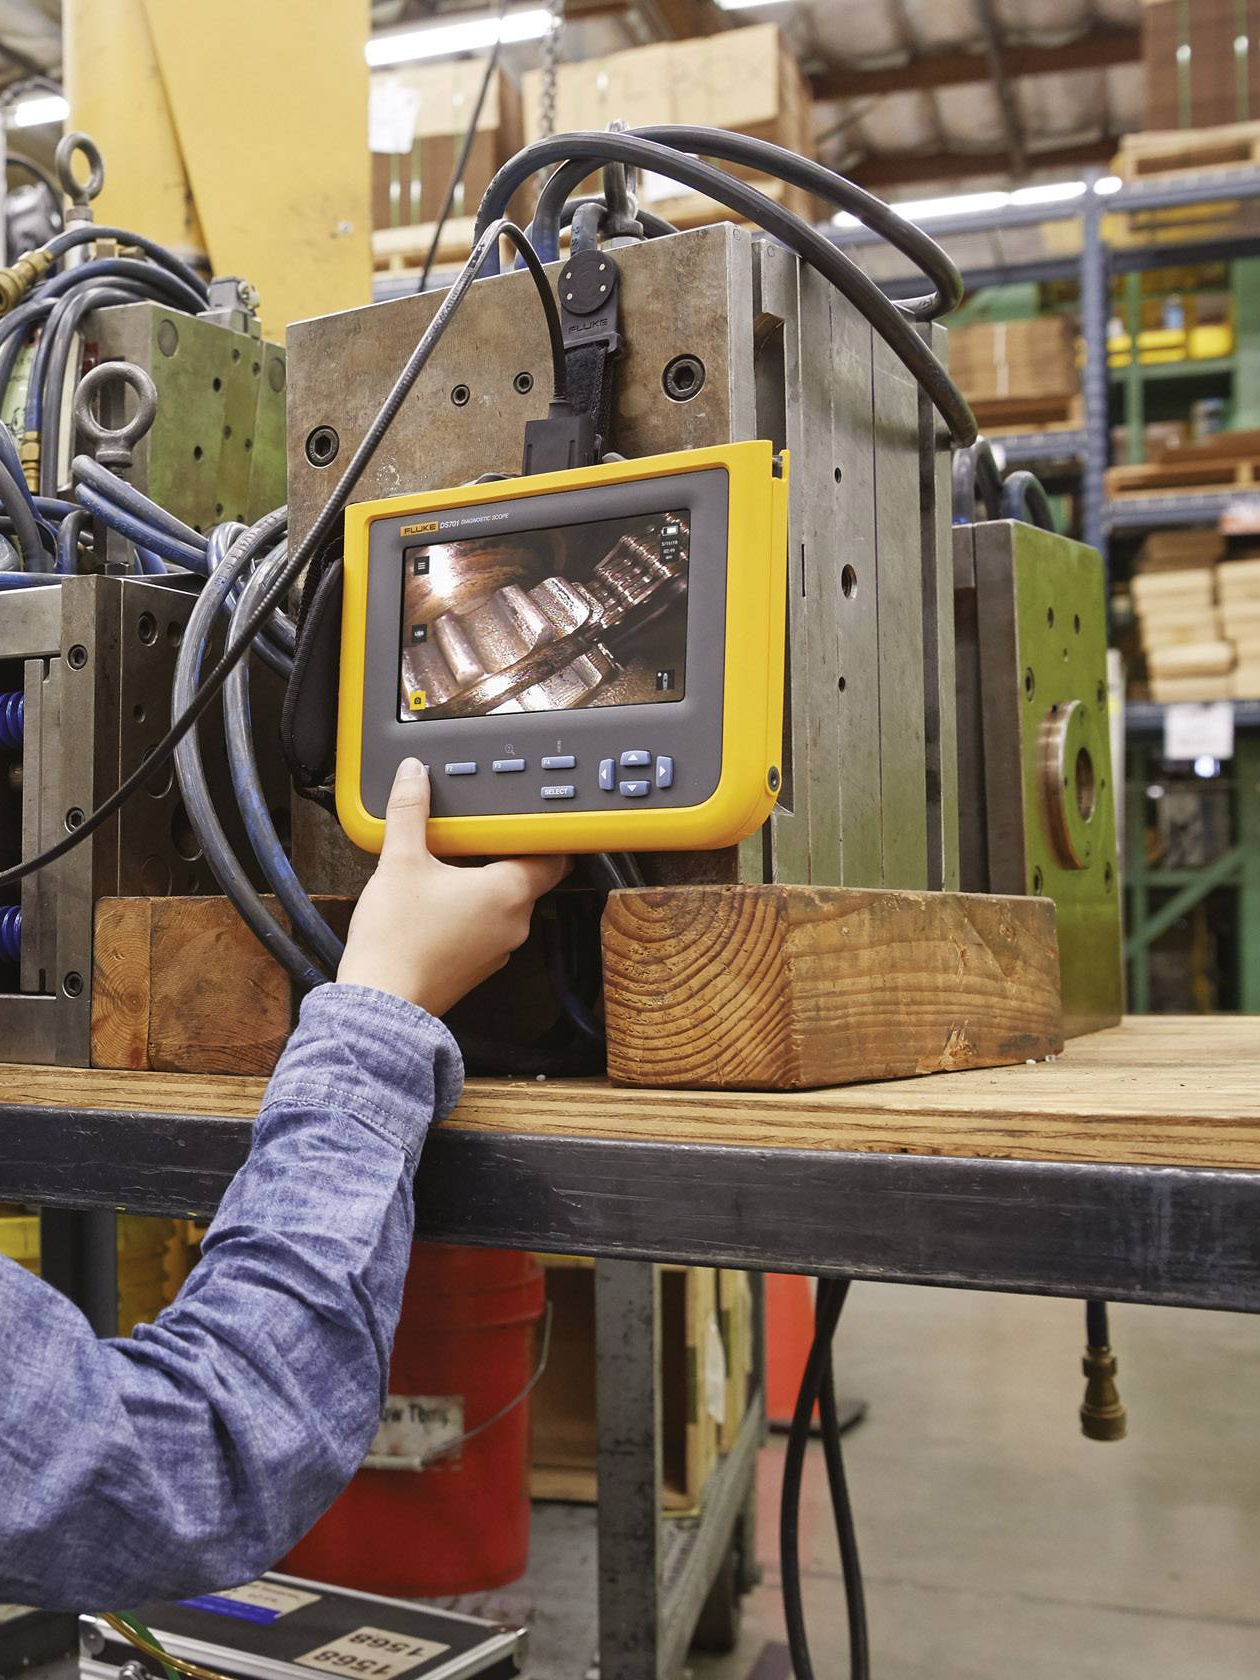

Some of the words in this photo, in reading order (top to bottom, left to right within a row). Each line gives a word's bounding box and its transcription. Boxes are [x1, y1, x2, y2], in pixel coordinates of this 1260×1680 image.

[568, 318, 608, 334] FLUKE
[403, 522, 437, 535] FLUKE
[439, 519, 460, 529] DS701
[460, 515, 491, 525] DIAGNOSTIC
[492, 512, 509, 521] SCOPE
[544, 788, 569, 796] SELECT
[349, 1633, 424, 1656] 1568
[313, 1650, 392, 1675] 1568
